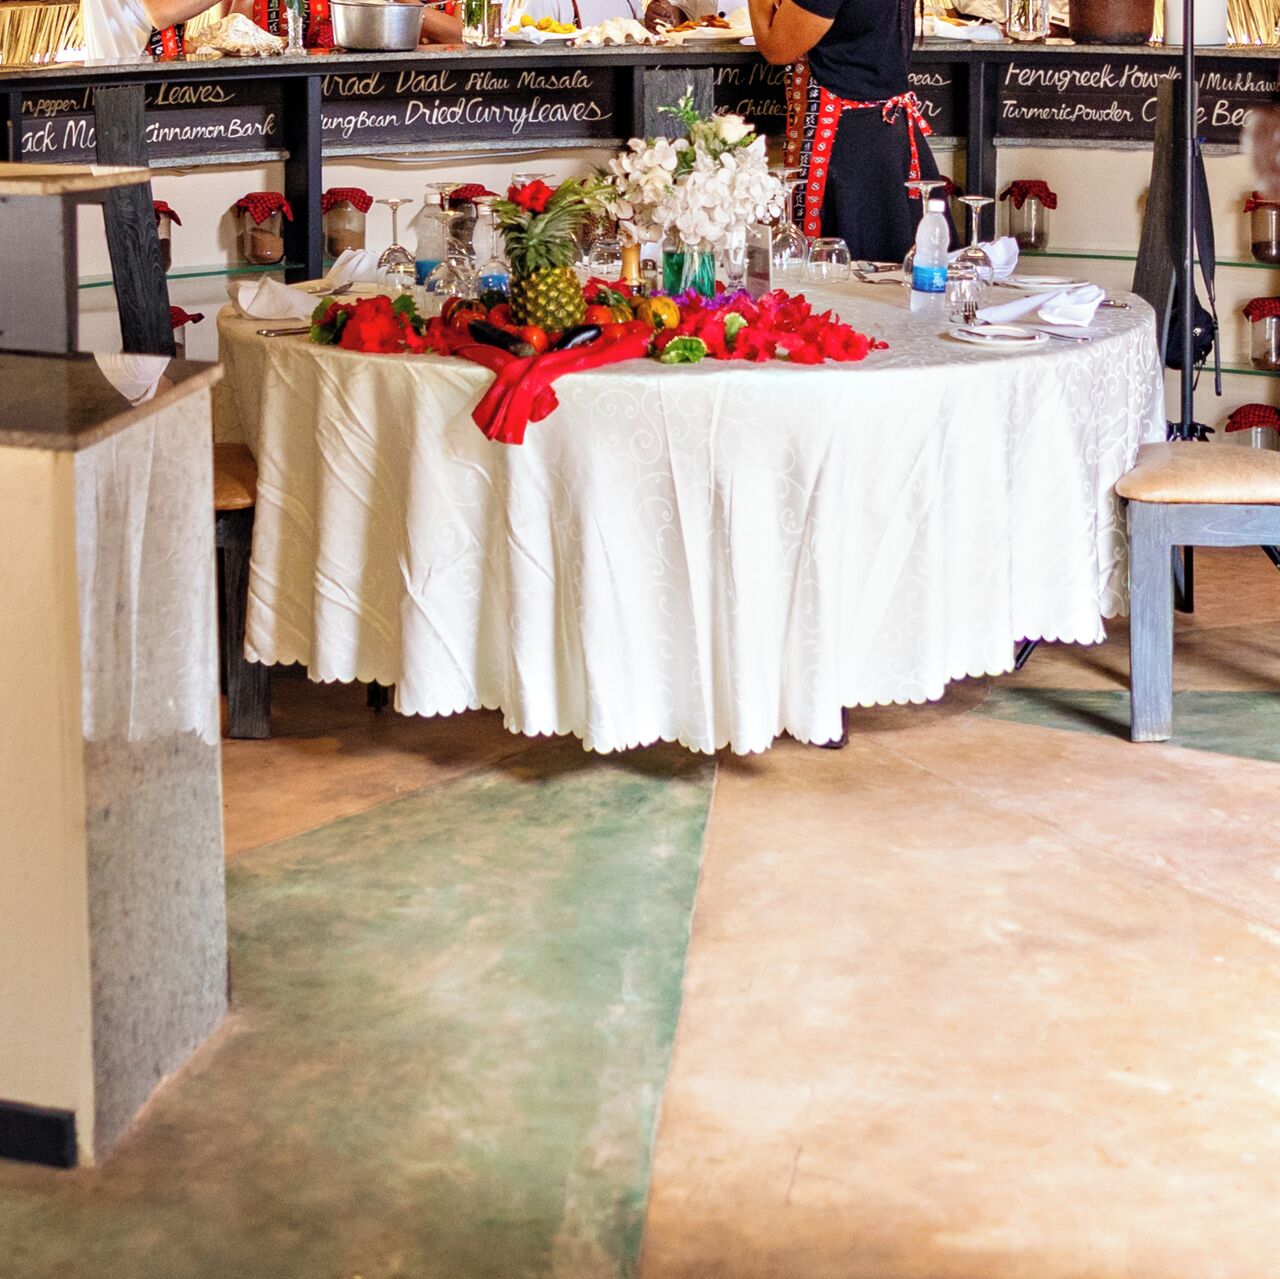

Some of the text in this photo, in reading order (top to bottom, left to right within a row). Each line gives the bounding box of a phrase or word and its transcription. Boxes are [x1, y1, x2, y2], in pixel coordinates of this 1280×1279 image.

[516, 70, 594, 90] Masala
[1004, 62, 1119, 92] Fenugreek
[153, 81, 235, 106] Leaves
[404, 97, 466, 125] Dried
[466, 98, 530, 134] Curry
[528, 96, 612, 124] Leaves
[1002, 100, 1073, 120] Turmeric
[1071, 101, 1134, 122] Powder
[21, 121, 58, 153] ack
[227, 113, 277, 139] Bark
